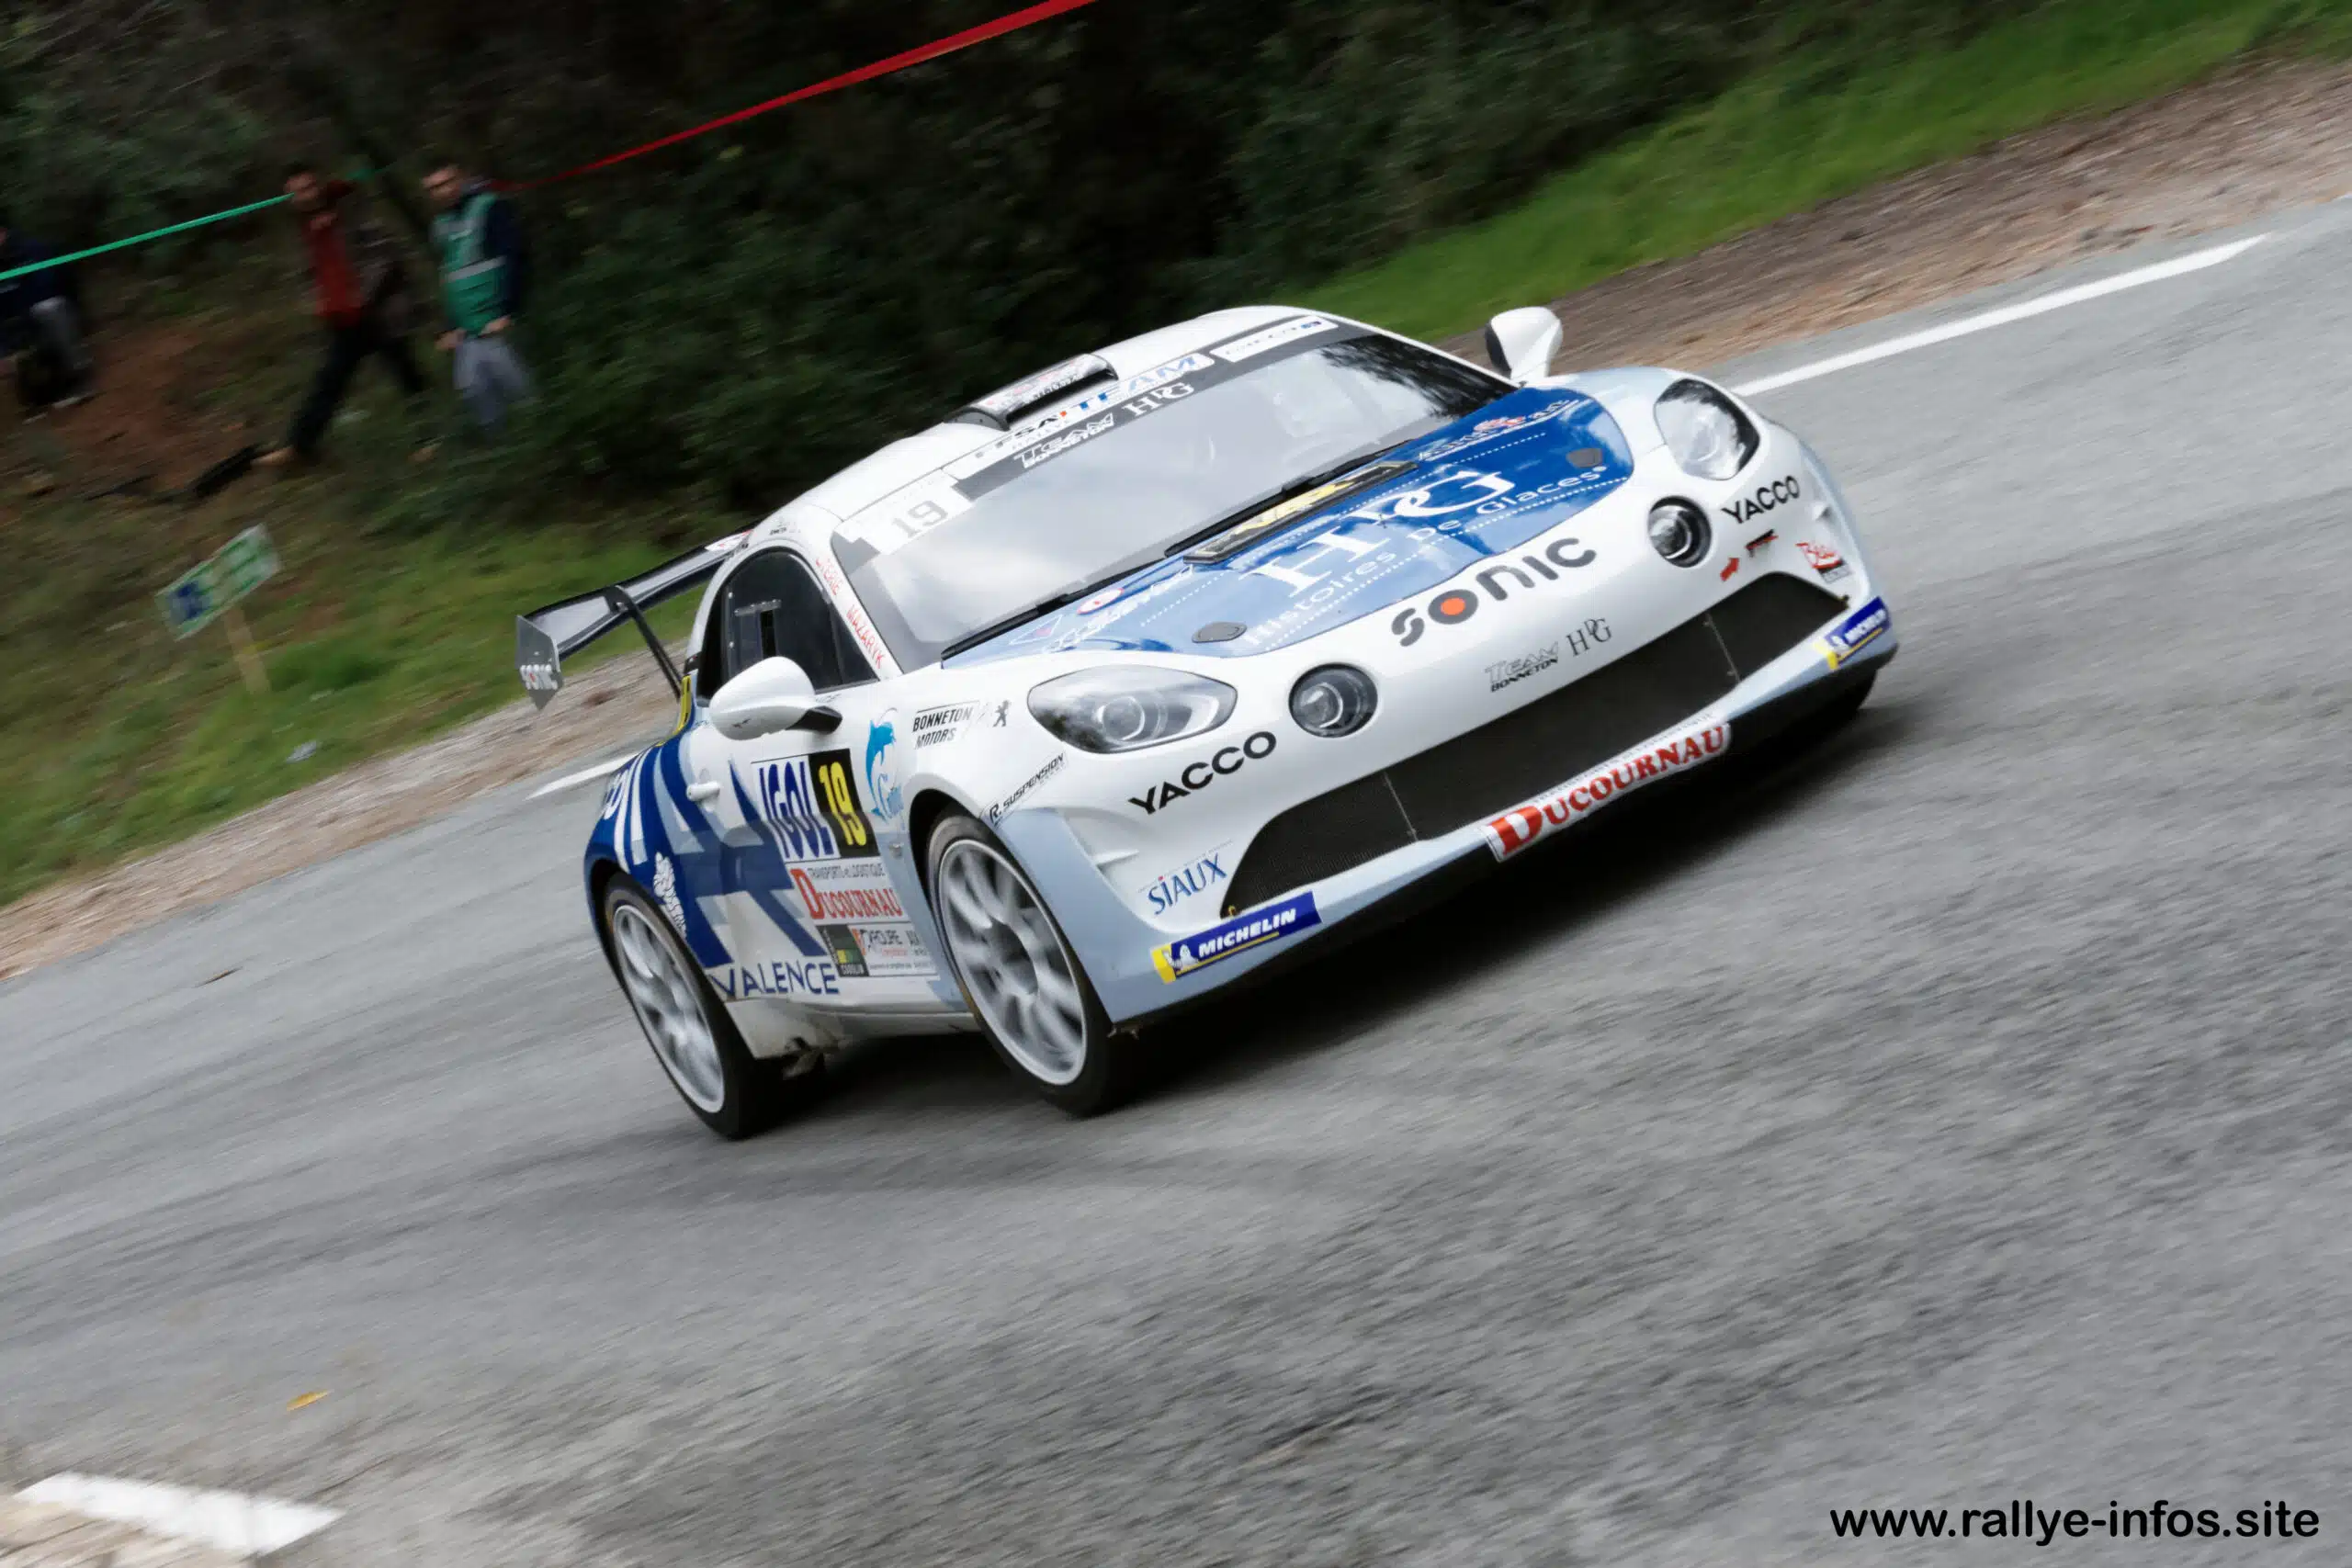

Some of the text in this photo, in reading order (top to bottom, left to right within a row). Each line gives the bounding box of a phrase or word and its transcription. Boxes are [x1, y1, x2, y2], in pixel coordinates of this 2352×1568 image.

[891, 501, 948, 538] 19
[1721, 475, 1800, 524] YACCO
[1490, 657, 1559, 694] BONNETON
[912, 706, 974, 733] BONNETON
[914, 727, 957, 750] MOTORS
[1003, 752, 1065, 809] SUSPENSION
[1128, 731, 1277, 816] YACCO
[1488, 726, 1724, 856] DUCOURNAU
[758, 761, 835, 860] IGOL
[818, 761, 867, 846] 19
[1197, 908, 1297, 958] MICHELIN
[708, 960, 840, 997] VALENCE
